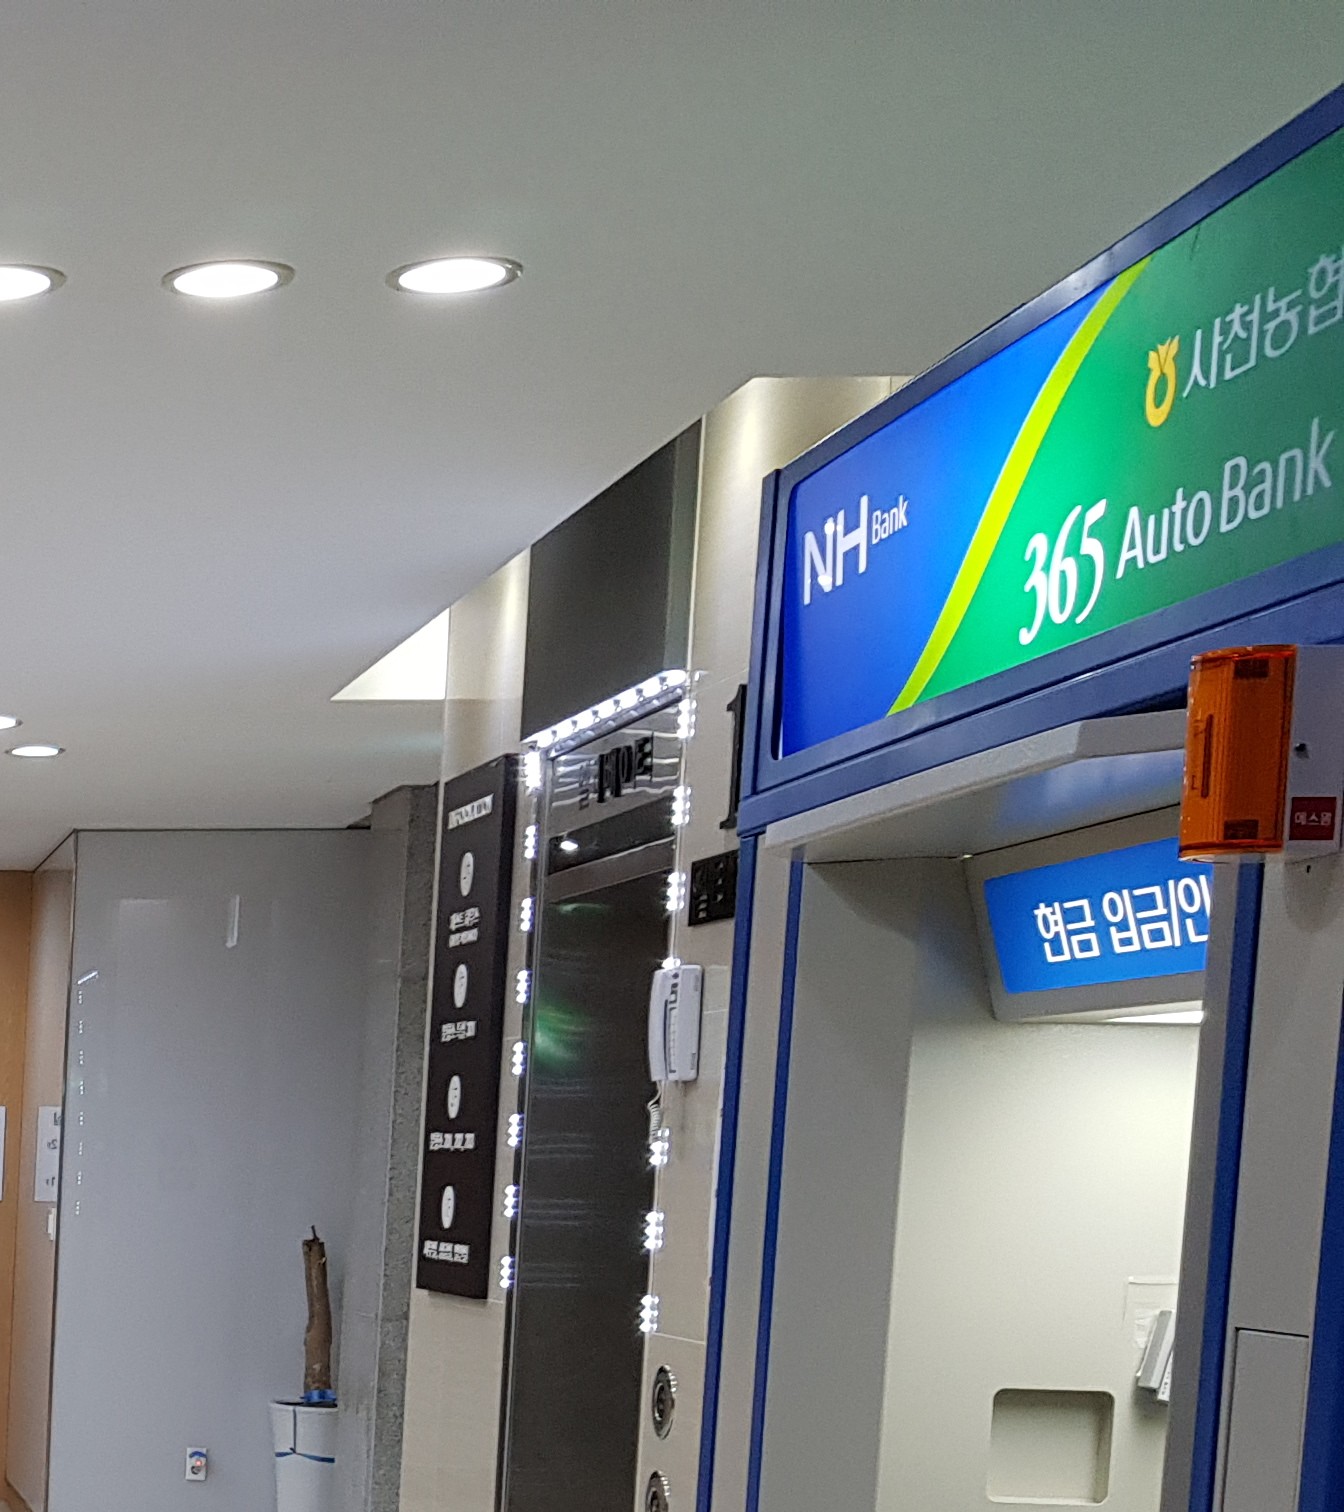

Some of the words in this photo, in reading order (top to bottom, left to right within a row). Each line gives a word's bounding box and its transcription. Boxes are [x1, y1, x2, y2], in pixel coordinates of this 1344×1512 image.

[1183, 246, 1344, 398] 사천농협
[803, 495, 868, 605] NH
[872, 496, 911, 545] Bank
[1019, 498, 1108, 646] 365
[1116, 487, 1213, 580] Auto
[1220, 417, 1337, 534] Bank
[1033, 898, 1101, 963] 현금
